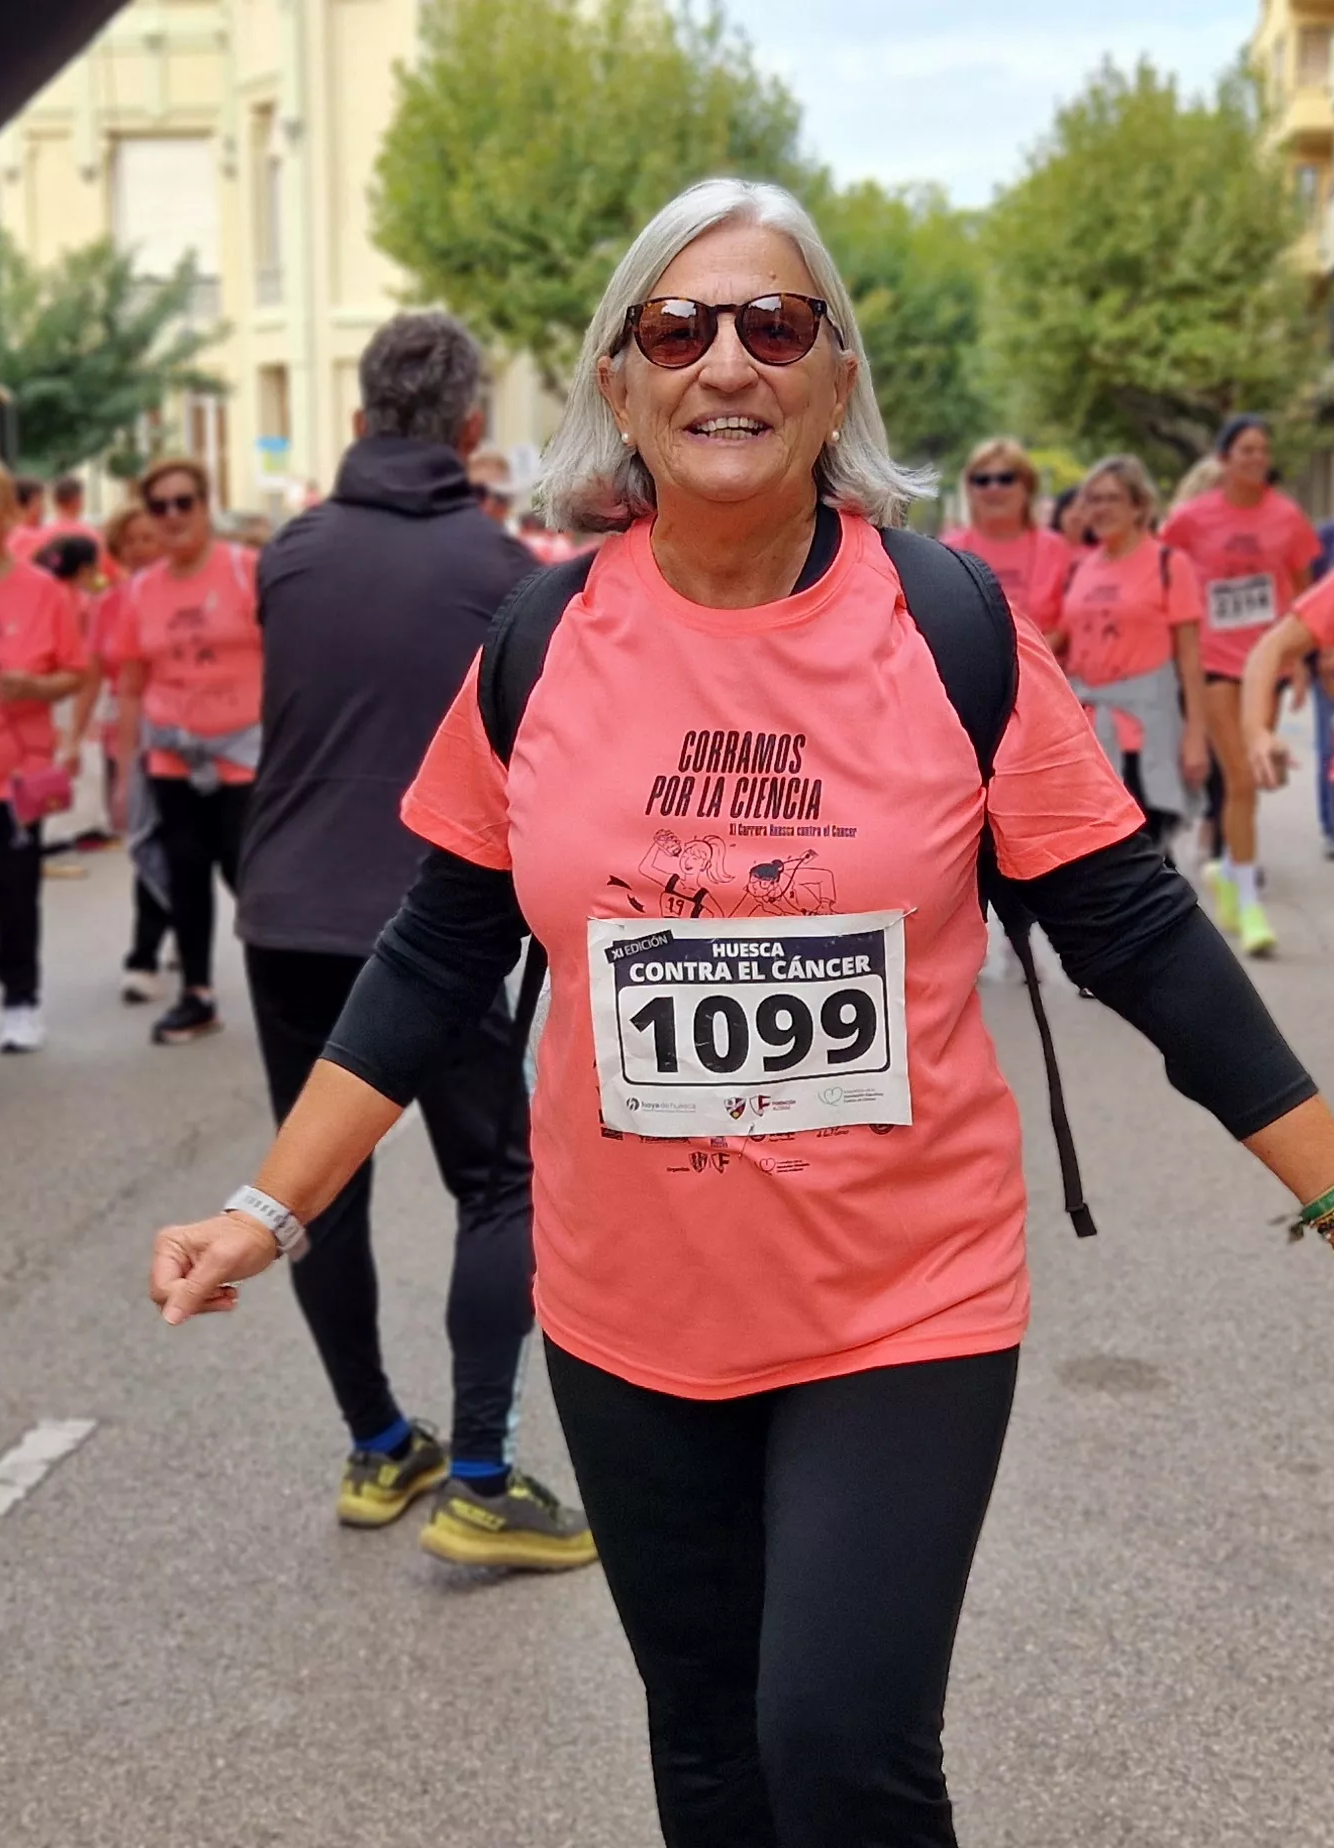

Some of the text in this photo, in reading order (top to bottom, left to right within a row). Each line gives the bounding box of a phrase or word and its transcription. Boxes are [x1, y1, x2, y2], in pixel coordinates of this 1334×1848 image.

[677, 730, 807, 774] CORRAMOS
[644, 775, 822, 820] POR LA CIENCIA
[610, 934, 669, 961] XI EDICIÓN
[712, 941, 785, 958] HUESCA
[629, 954, 872, 983] CONTRA EL CÁNCER
[629, 988, 877, 1074] 1099
